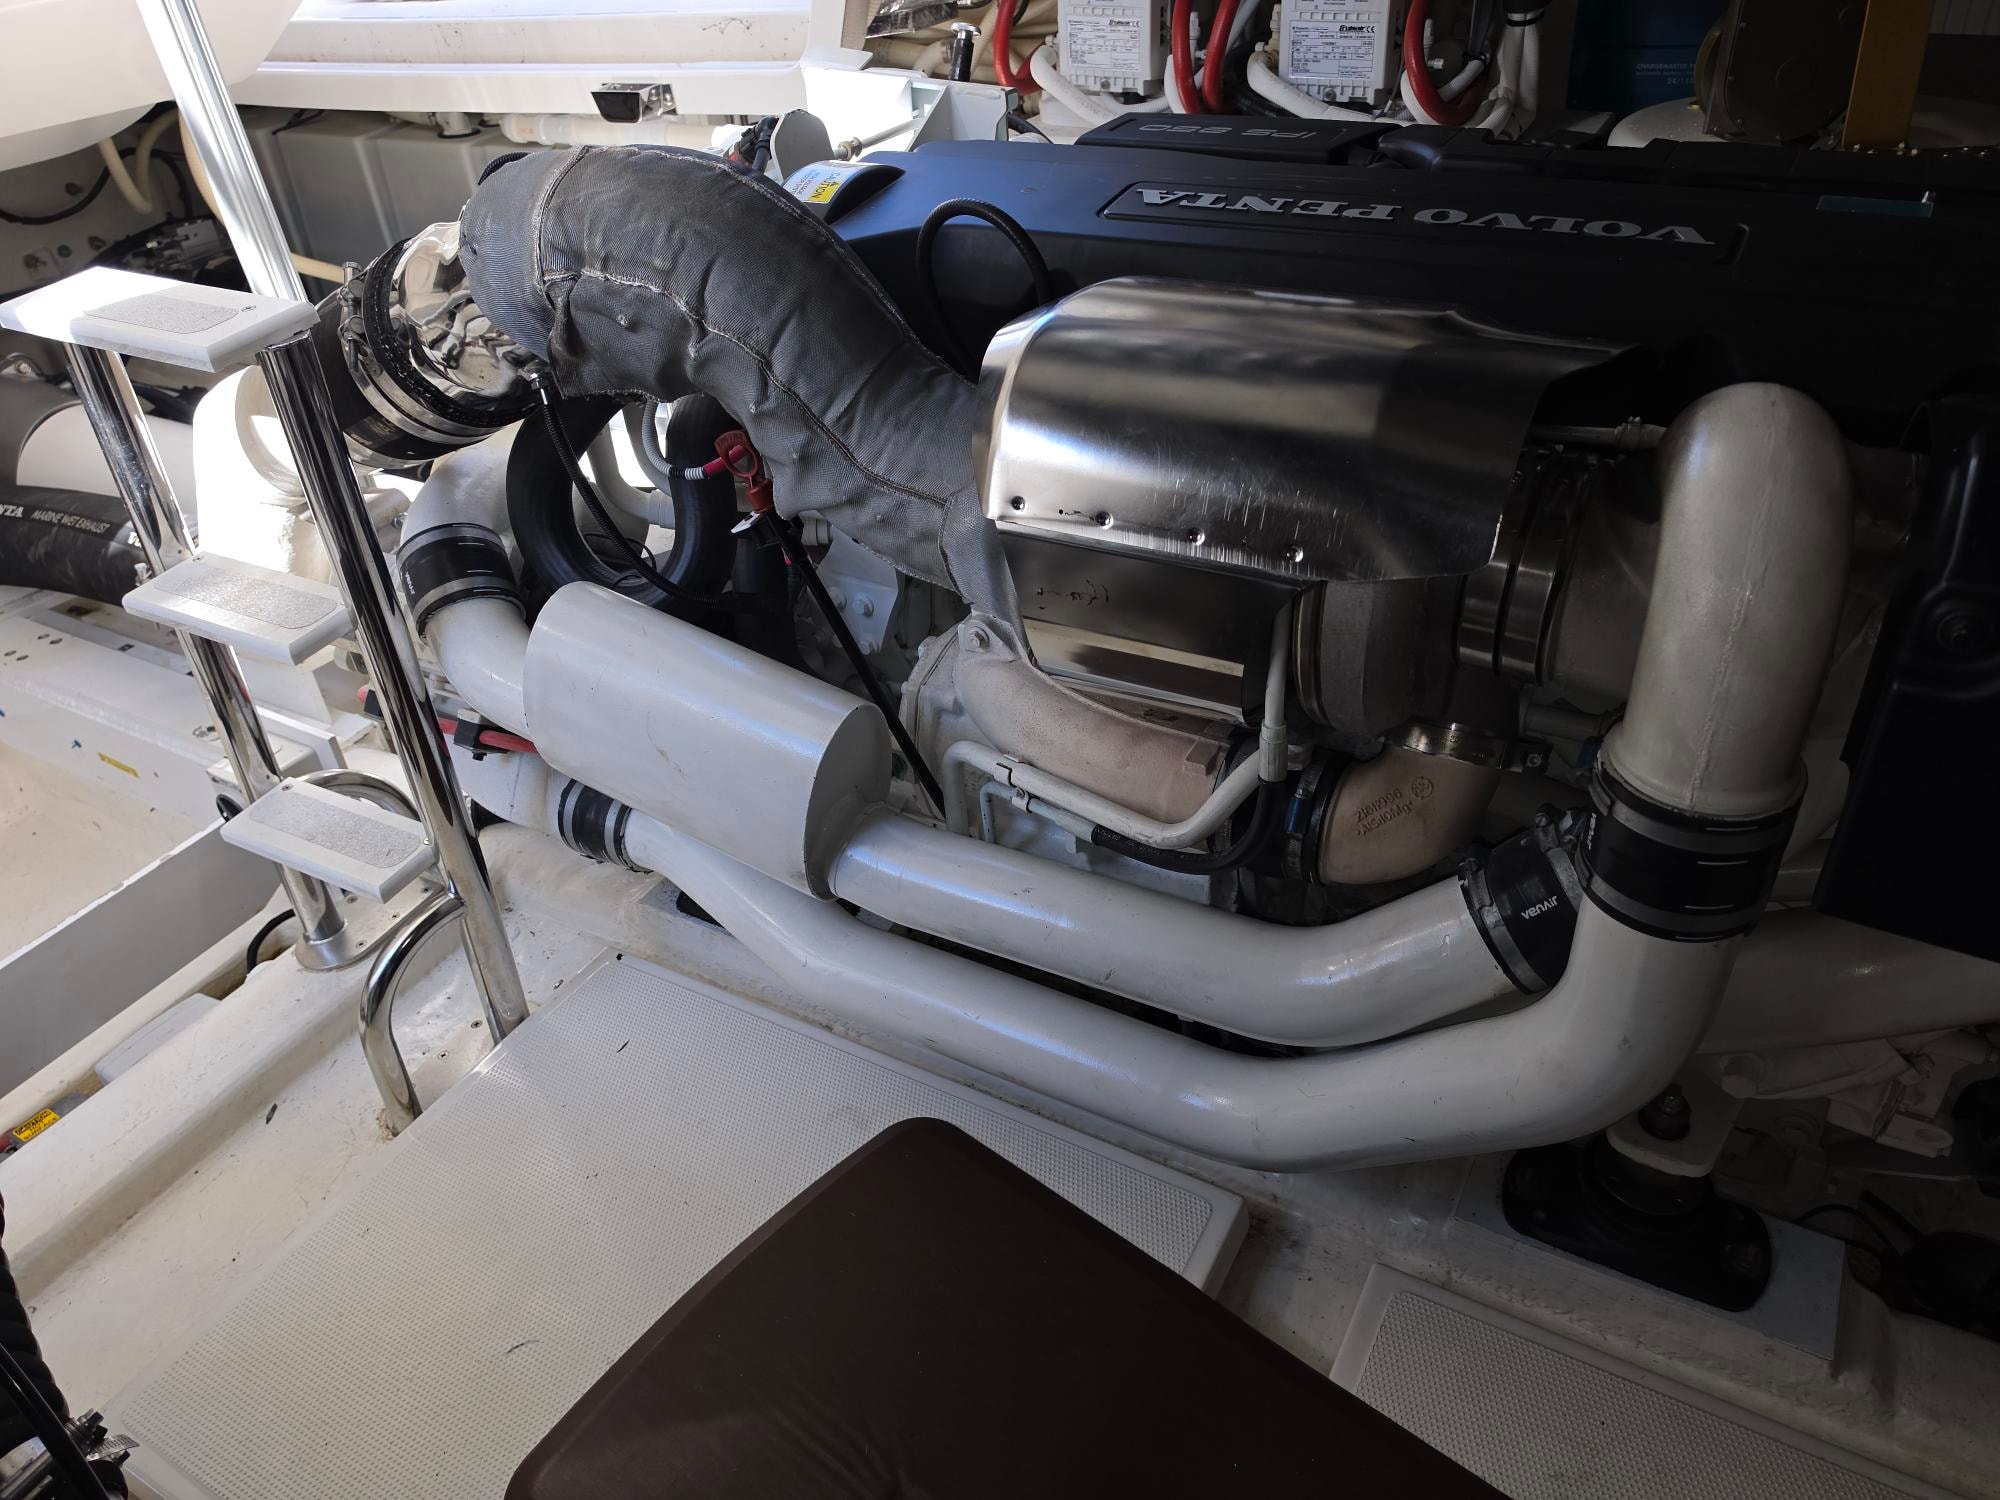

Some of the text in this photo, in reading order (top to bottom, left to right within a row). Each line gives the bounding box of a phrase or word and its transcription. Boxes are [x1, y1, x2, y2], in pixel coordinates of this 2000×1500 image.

[1241, 128, 1317, 139] IPS
[811, 172, 840, 198] CAUTION
[1136, 188, 1716, 245] VOLVO PENTA
[30, 509, 63, 523] MARINE
[61, 514, 79, 527] WET
[75, 518, 110, 534] EXHAUST
